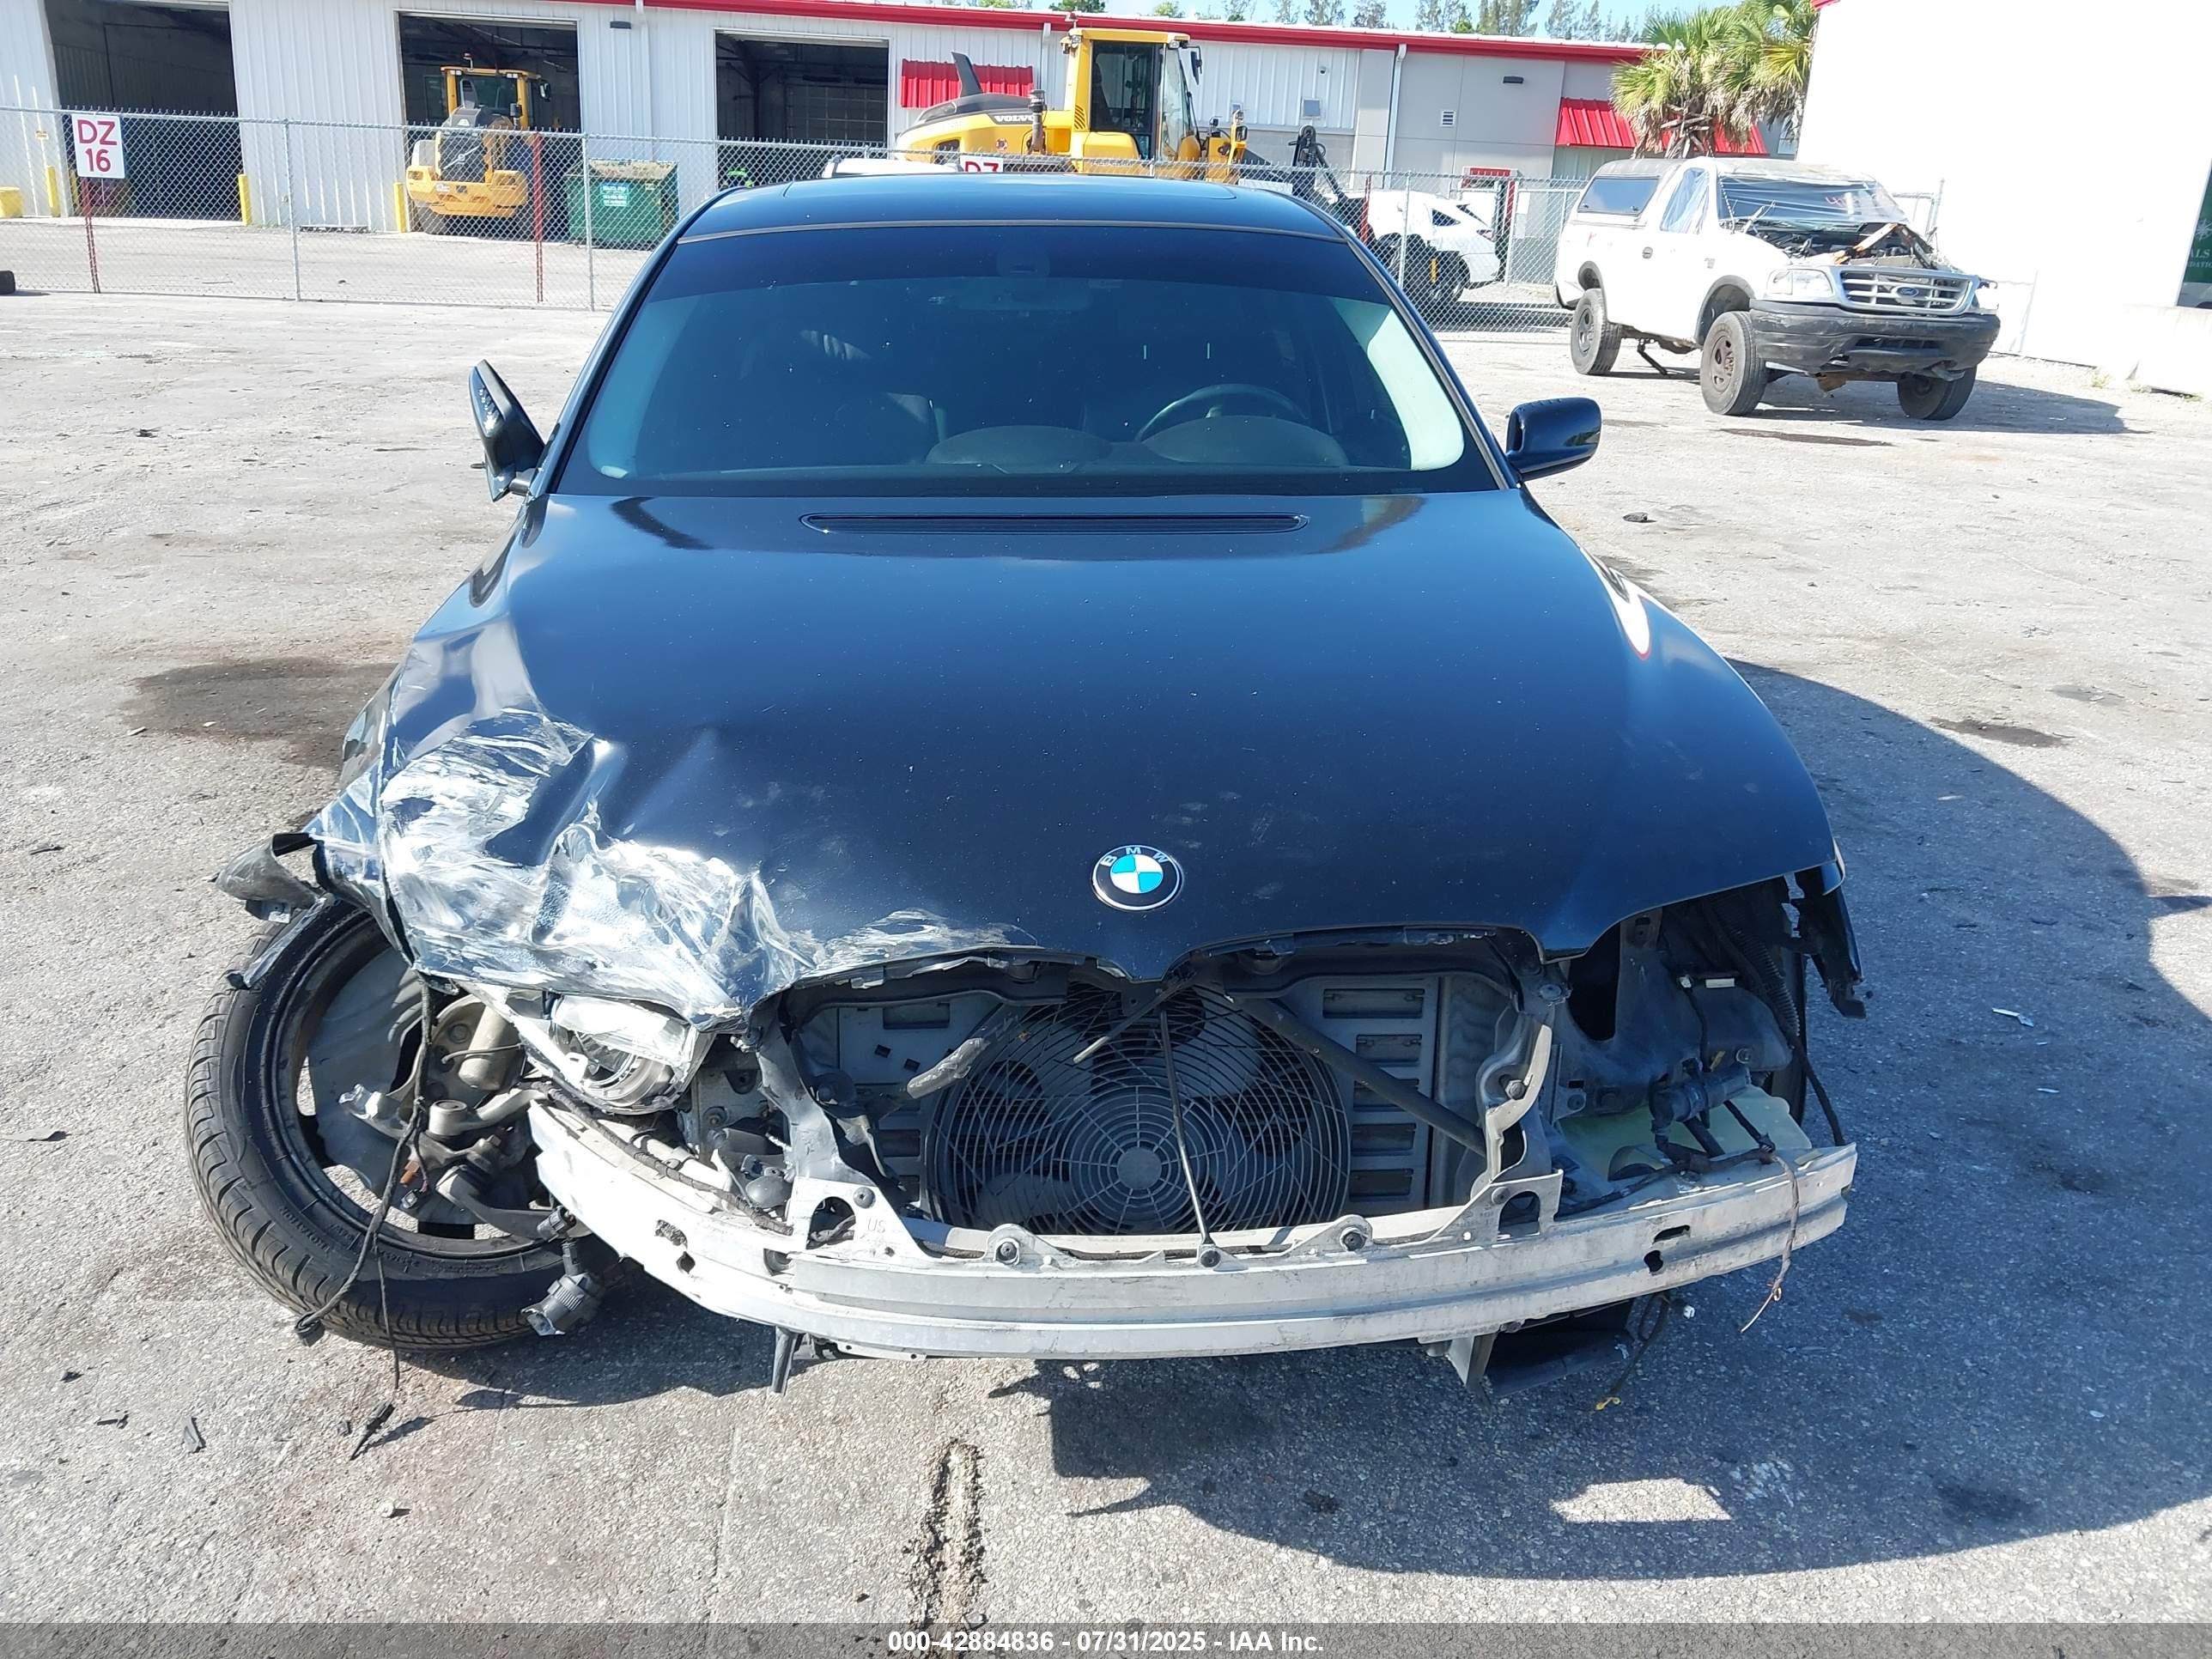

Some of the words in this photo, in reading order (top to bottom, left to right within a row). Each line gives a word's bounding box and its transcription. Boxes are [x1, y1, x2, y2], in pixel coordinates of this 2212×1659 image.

[77, 119, 118, 146] DZ
[85, 148, 111, 173] 16
[1100, 847, 1169, 866] BMW
